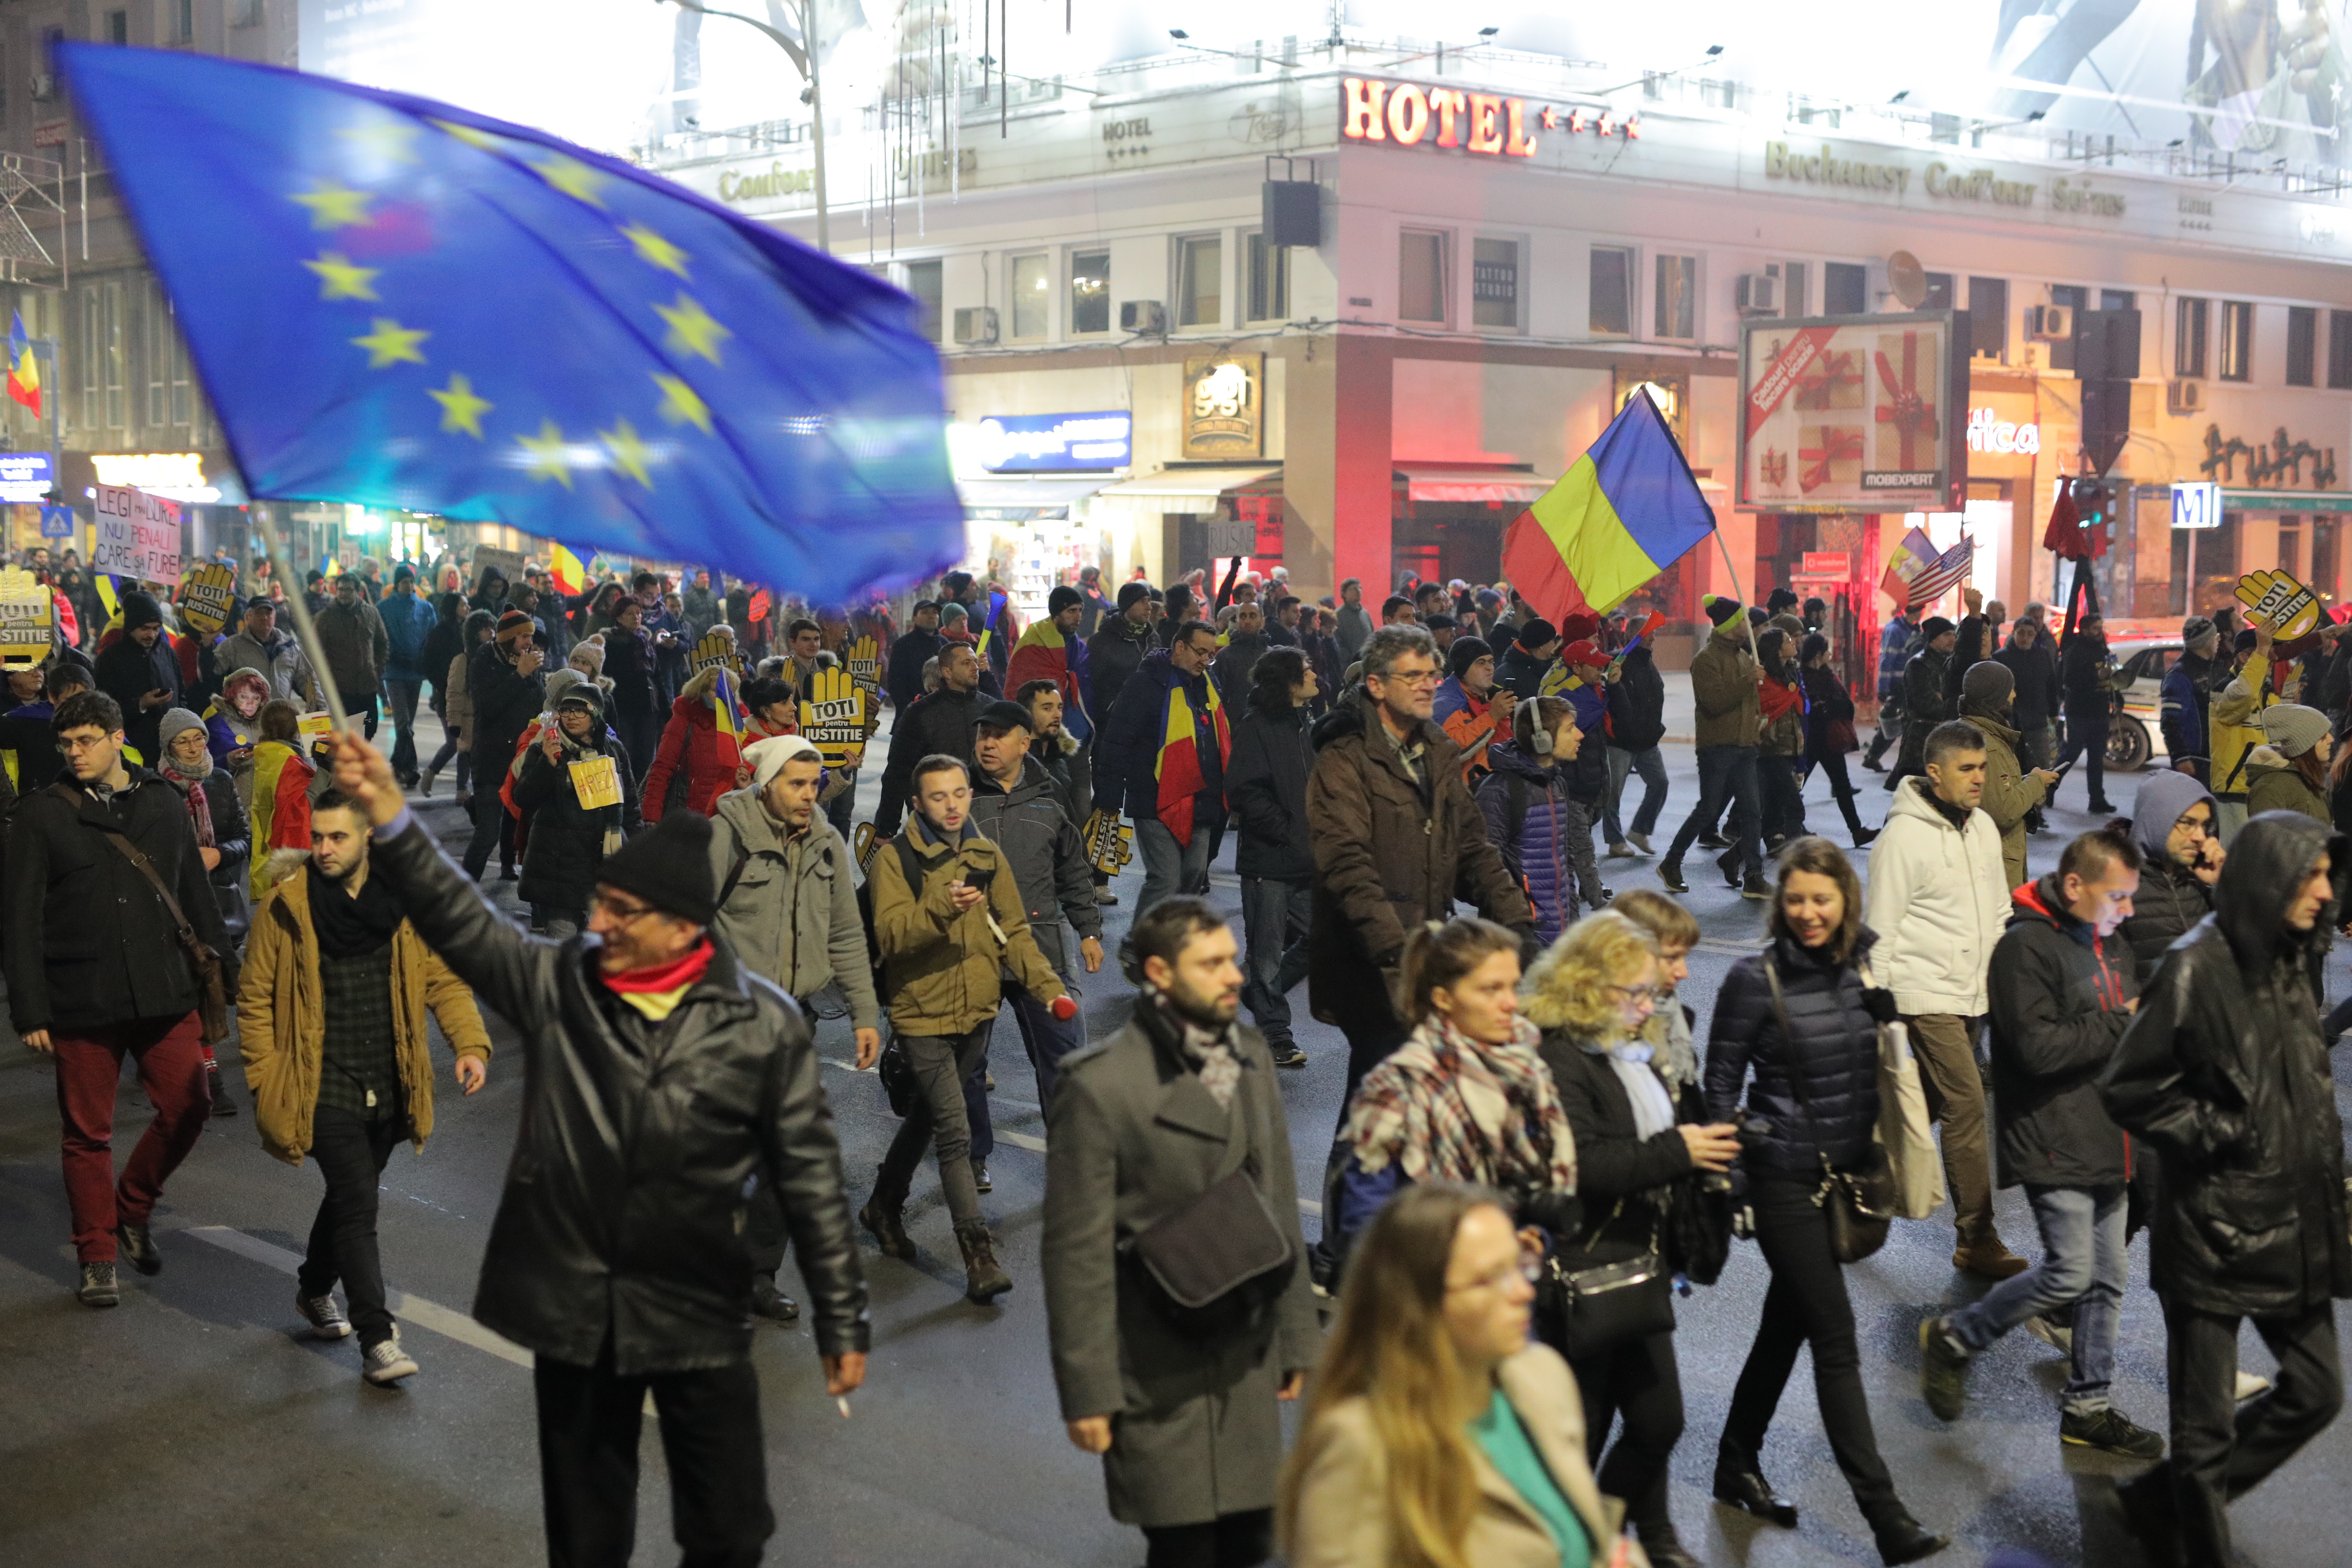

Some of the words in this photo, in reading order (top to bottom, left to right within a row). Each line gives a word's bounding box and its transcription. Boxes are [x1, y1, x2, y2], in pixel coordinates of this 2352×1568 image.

[1344, 77, 1537, 158] HOTEL
[1103, 117, 1152, 141] HOTEL
[1866, 473, 1935, 486] MOBEXPERT
[2172, 488, 2204, 524] M
[105, 522, 124, 540] NU
[96, 543, 131, 569] CARE
[0, 629, 50, 643] STIȚIE
[811, 699, 854, 719] TOȚI
[805, 728, 863, 742] JUSTIȚIE
